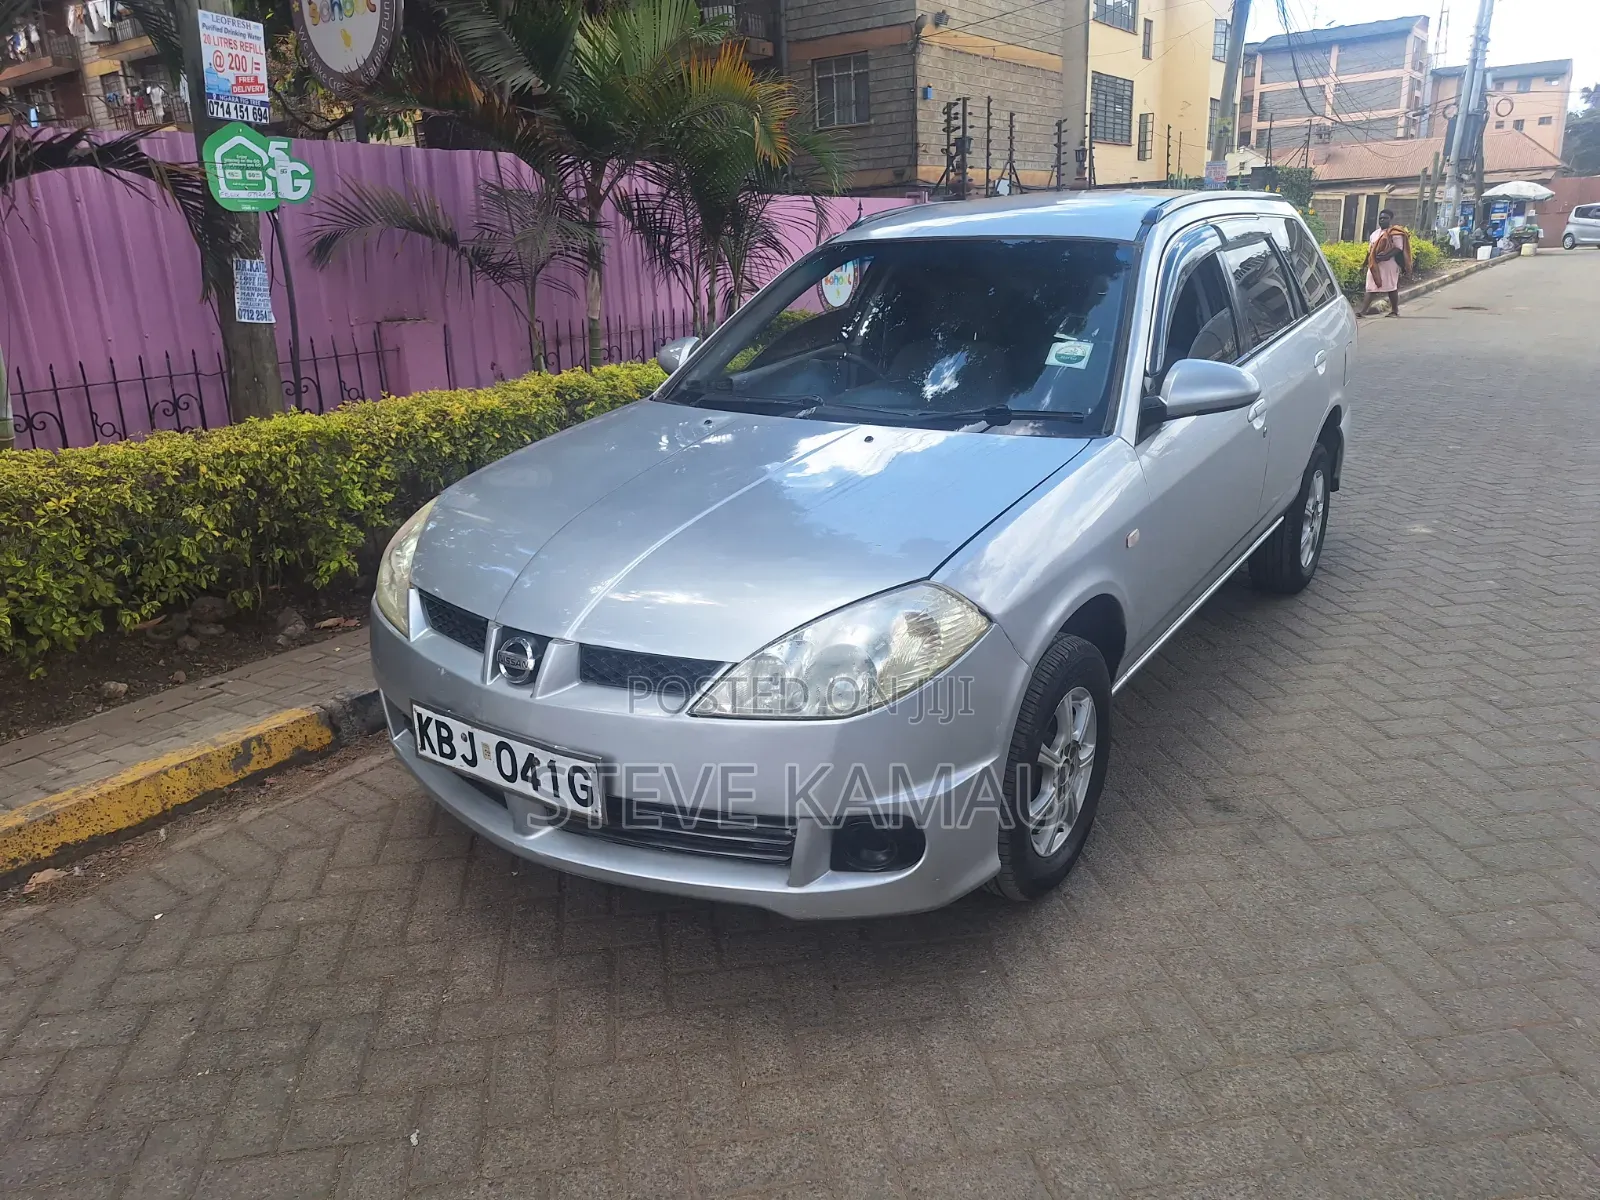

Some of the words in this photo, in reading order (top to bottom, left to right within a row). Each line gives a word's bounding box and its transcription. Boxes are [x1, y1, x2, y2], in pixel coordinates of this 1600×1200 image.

[211, 14, 252, 31] LEOFRESH
[382, 1, 390, 31] Fun
[202, 22, 223, 33] Purified
[224, 26, 247, 40] Drinking
[247, 32, 262, 41] Water
[203, 34, 212, 45] 20
[213, 36, 238, 51] LITRES
[240, 40, 263, 56] REFILL
[299, 24, 309, 51] We
[307, 51, 327, 83] Make
[227, 52, 248, 73] 200
[232, 85, 264, 93] DELIVERY
[208, 100, 231, 118] 0714
[234, 103, 249, 120] 151
[252, 106, 268, 123] 694
[266, 141, 311, 200] 5G
[416, 712, 478, 768] KBJ
[495, 740, 595, 808] 041G
